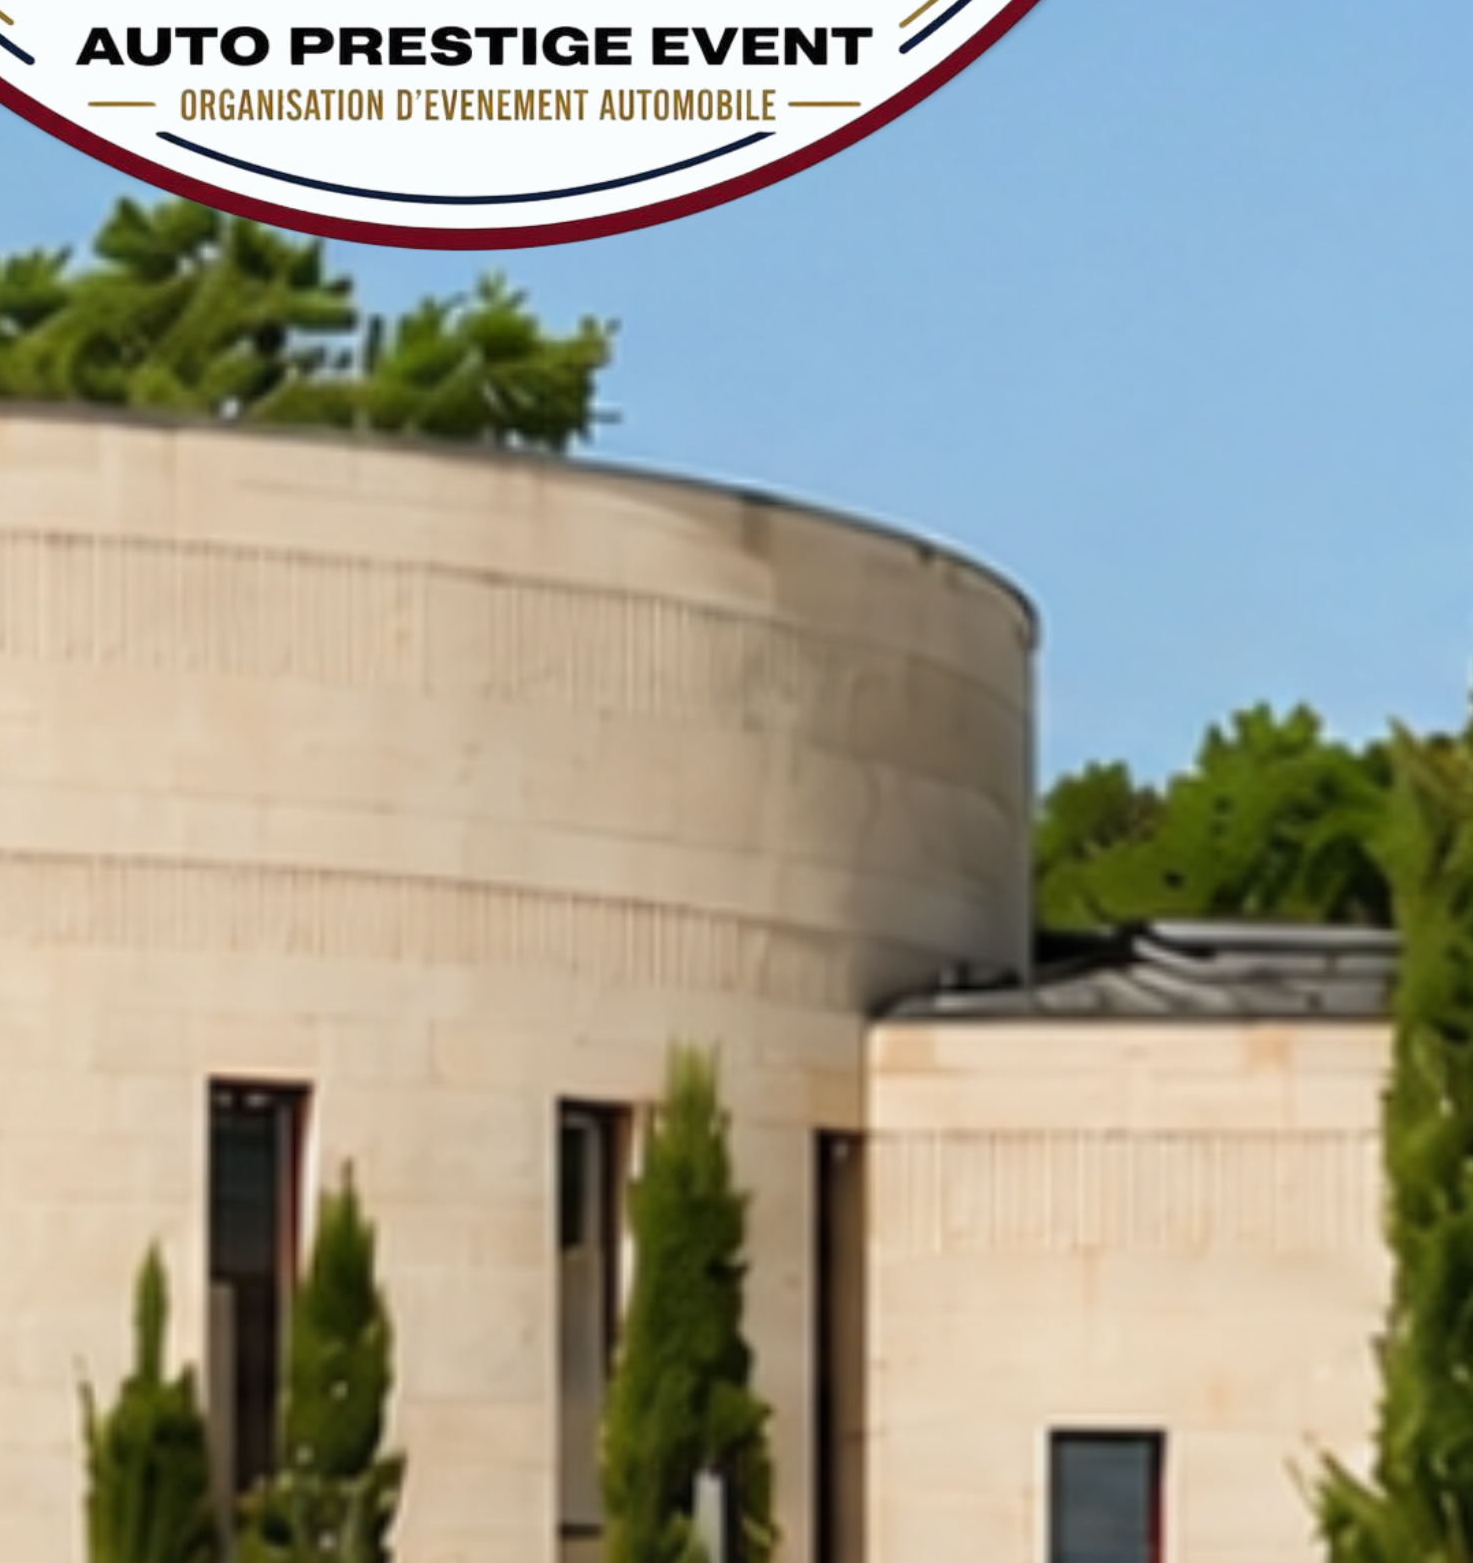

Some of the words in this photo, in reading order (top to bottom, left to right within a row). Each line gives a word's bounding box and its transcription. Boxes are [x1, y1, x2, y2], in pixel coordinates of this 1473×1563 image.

[75, 25, 270, 67] AUTO
[290, 25, 633, 67] PRESTIGE
[651, 27, 874, 66] EVENT
[179, 88, 385, 122] ORGANISATION
[599, 88, 777, 122] AUTOMOBILE
